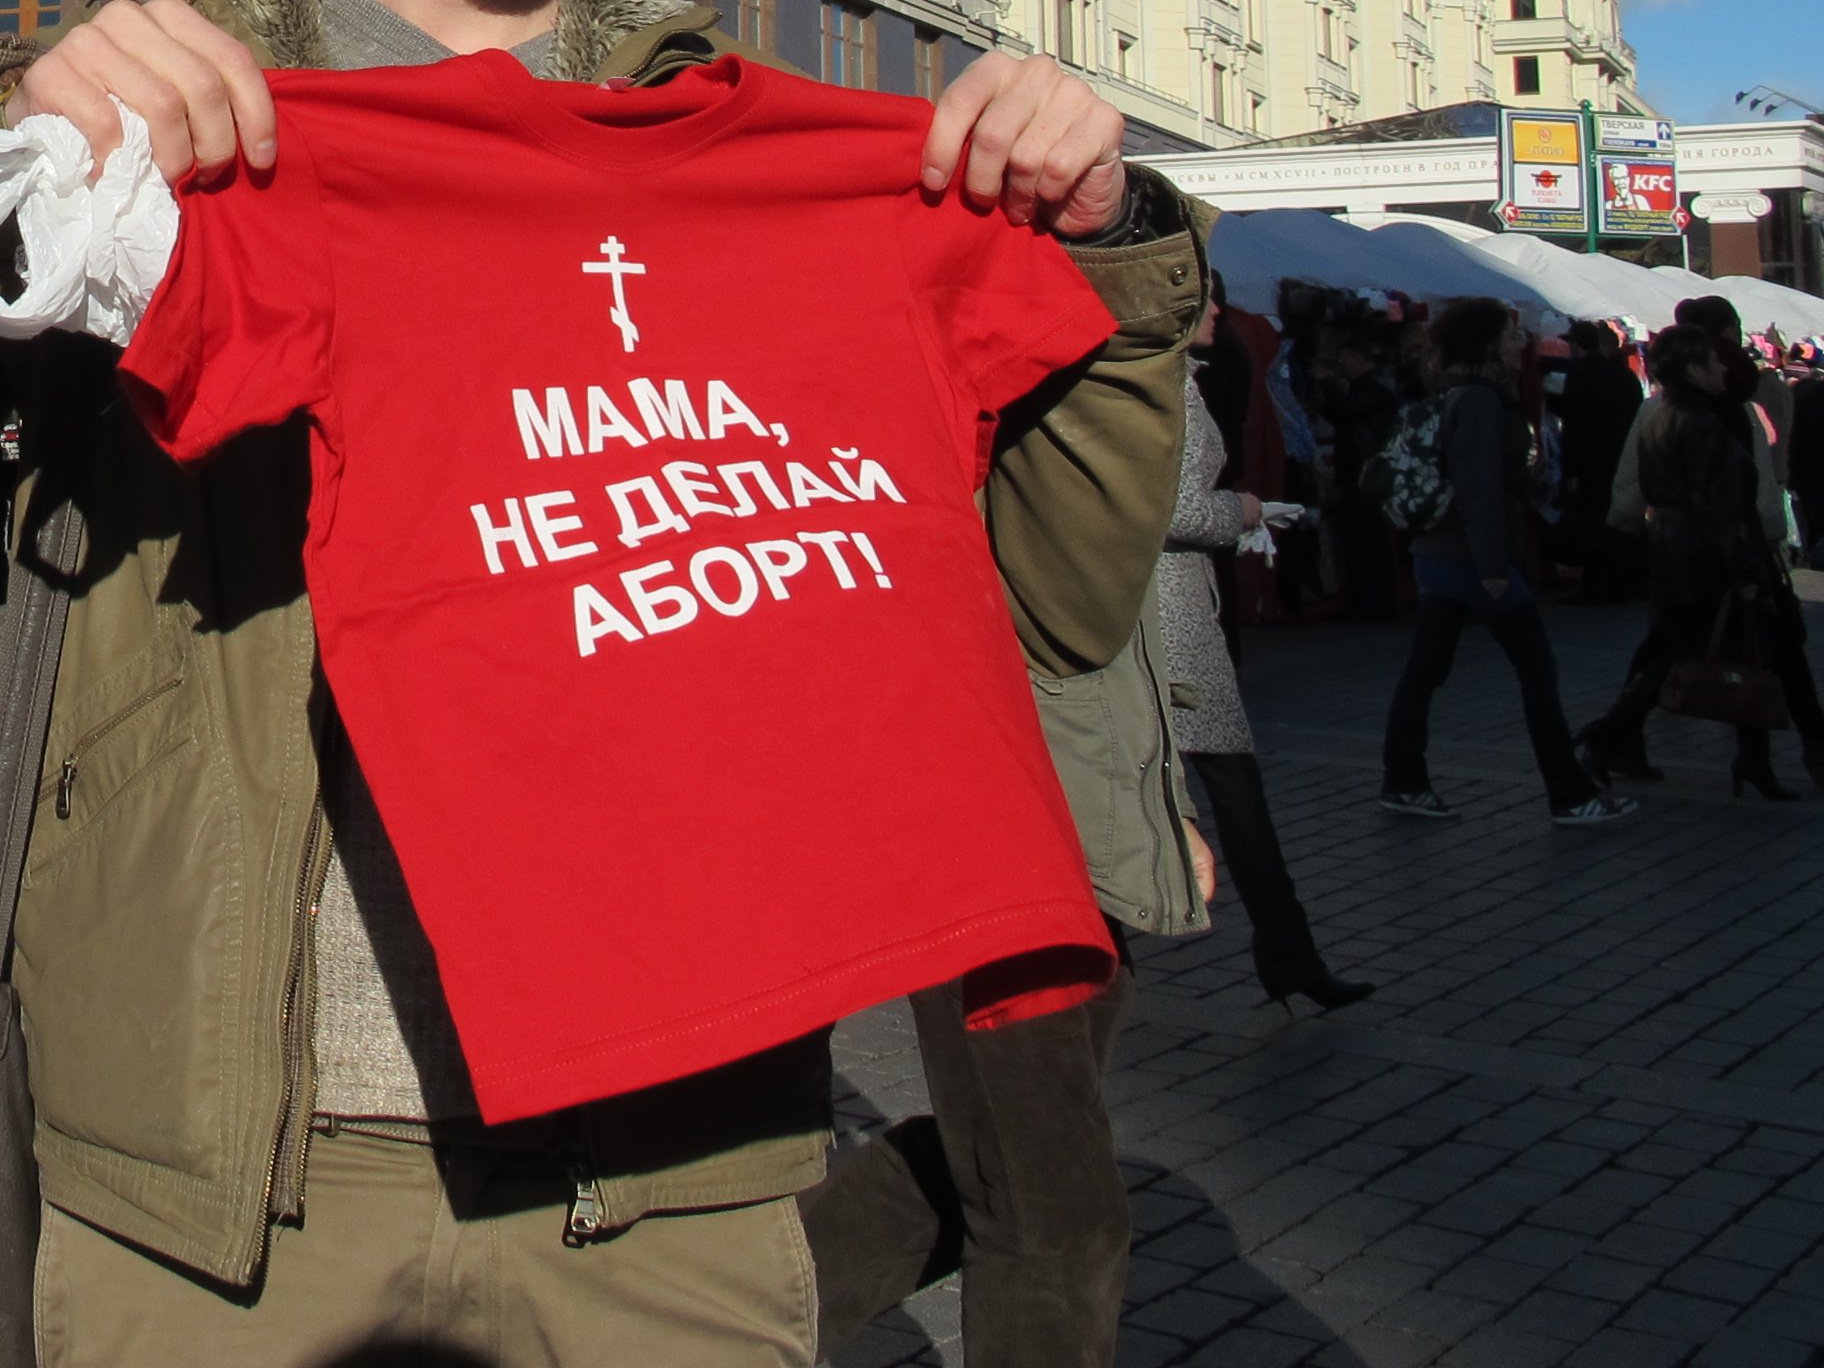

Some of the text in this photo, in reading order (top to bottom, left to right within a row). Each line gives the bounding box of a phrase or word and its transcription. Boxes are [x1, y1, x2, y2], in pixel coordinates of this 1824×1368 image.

[1601, 120, 1645, 130] ТВЕРСКАЯ
[1711, 146, 1774, 158] ГОРОДА
[1169, 173, 1217, 184] ОСКВЫ
[1333, 163, 1412, 177] ПОСТРОЕН
[1418, 163, 1426, 172] В
[1434, 160, 1462, 171] ГОД
[1468, 159, 1498, 169] ПРА
[1632, 174, 1672, 192] KFC
[511, 376, 791, 460] МАМА,
[470, 446, 908, 575] НЕ ДЕЛАЙ
[571, 530, 894, 658] АБОРТ!
